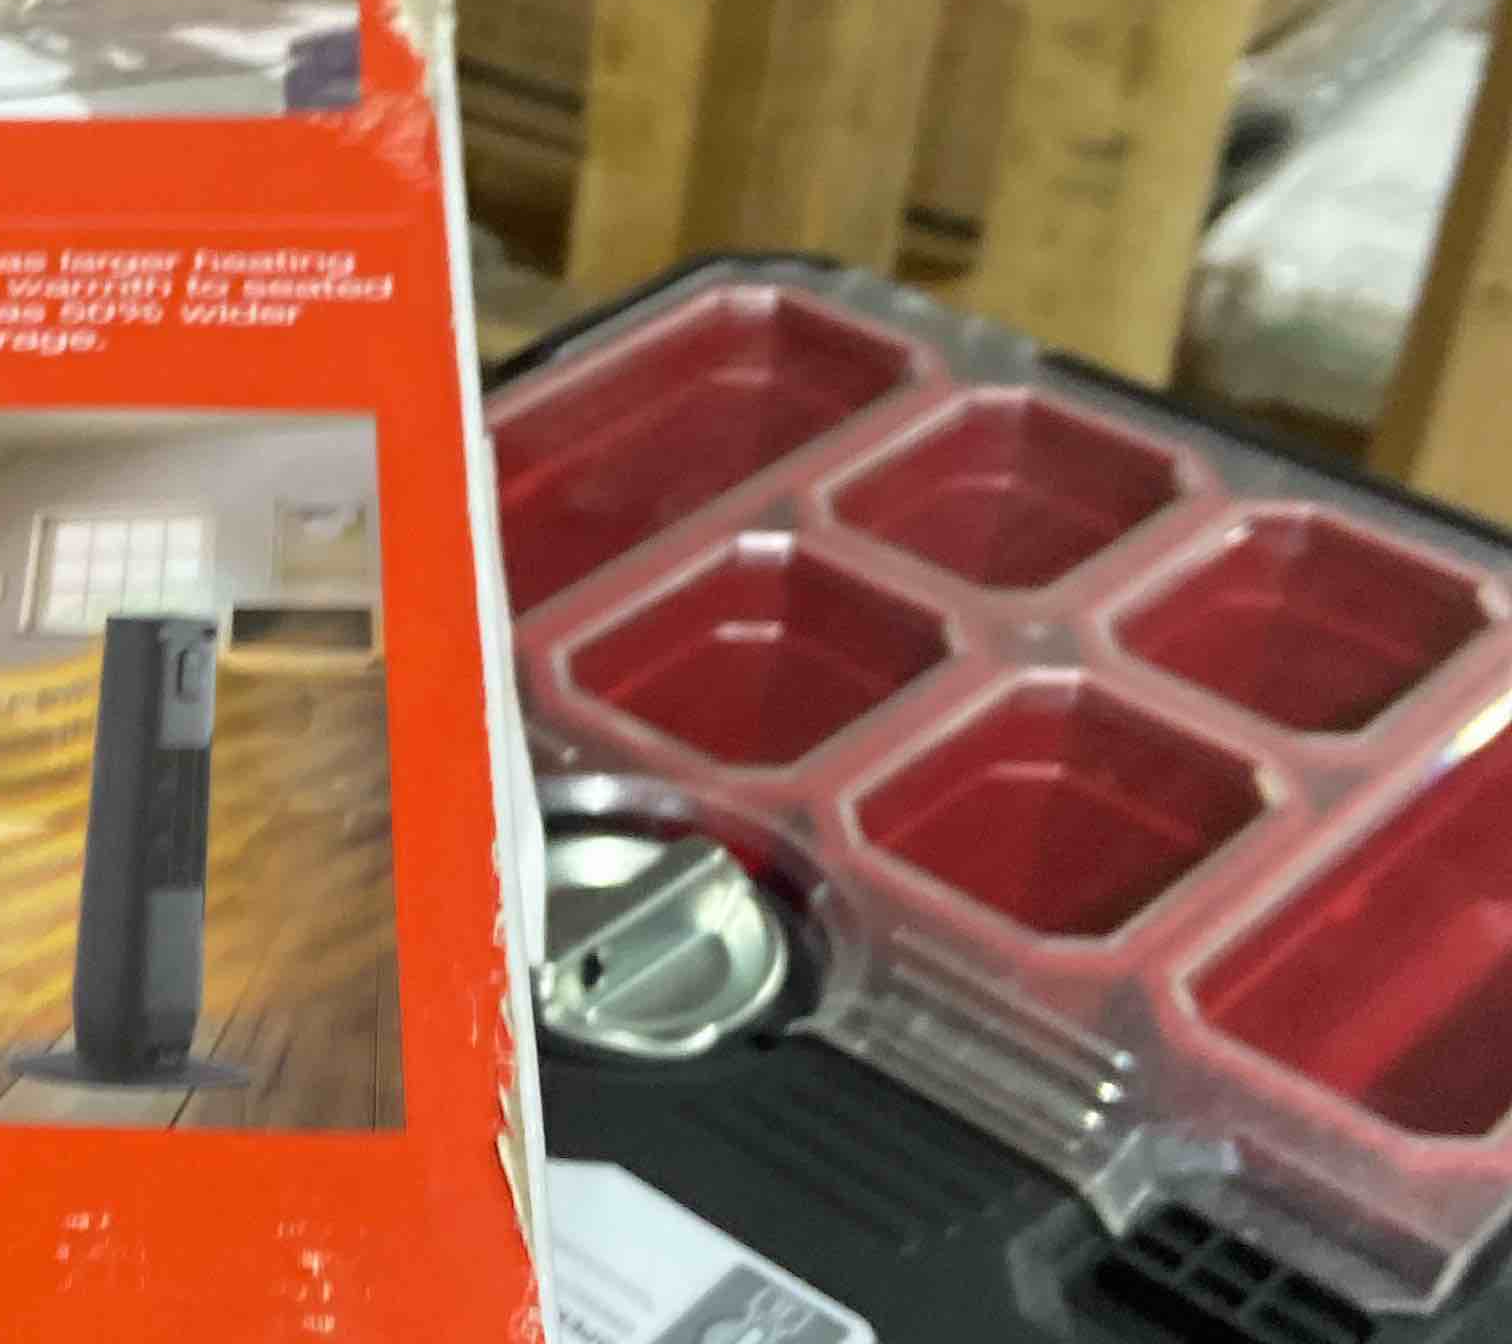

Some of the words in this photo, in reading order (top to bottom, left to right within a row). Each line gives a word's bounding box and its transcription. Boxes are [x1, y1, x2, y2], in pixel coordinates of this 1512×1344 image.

[60, 248, 180, 278] larger
[193, 249, 356, 278] heating
[7, 274, 171, 298] warmth
[186, 275, 231, 298] to
[243, 275, 392, 300] seated
[59, 299, 165, 324] 50%
[180, 301, 300, 326] wider
